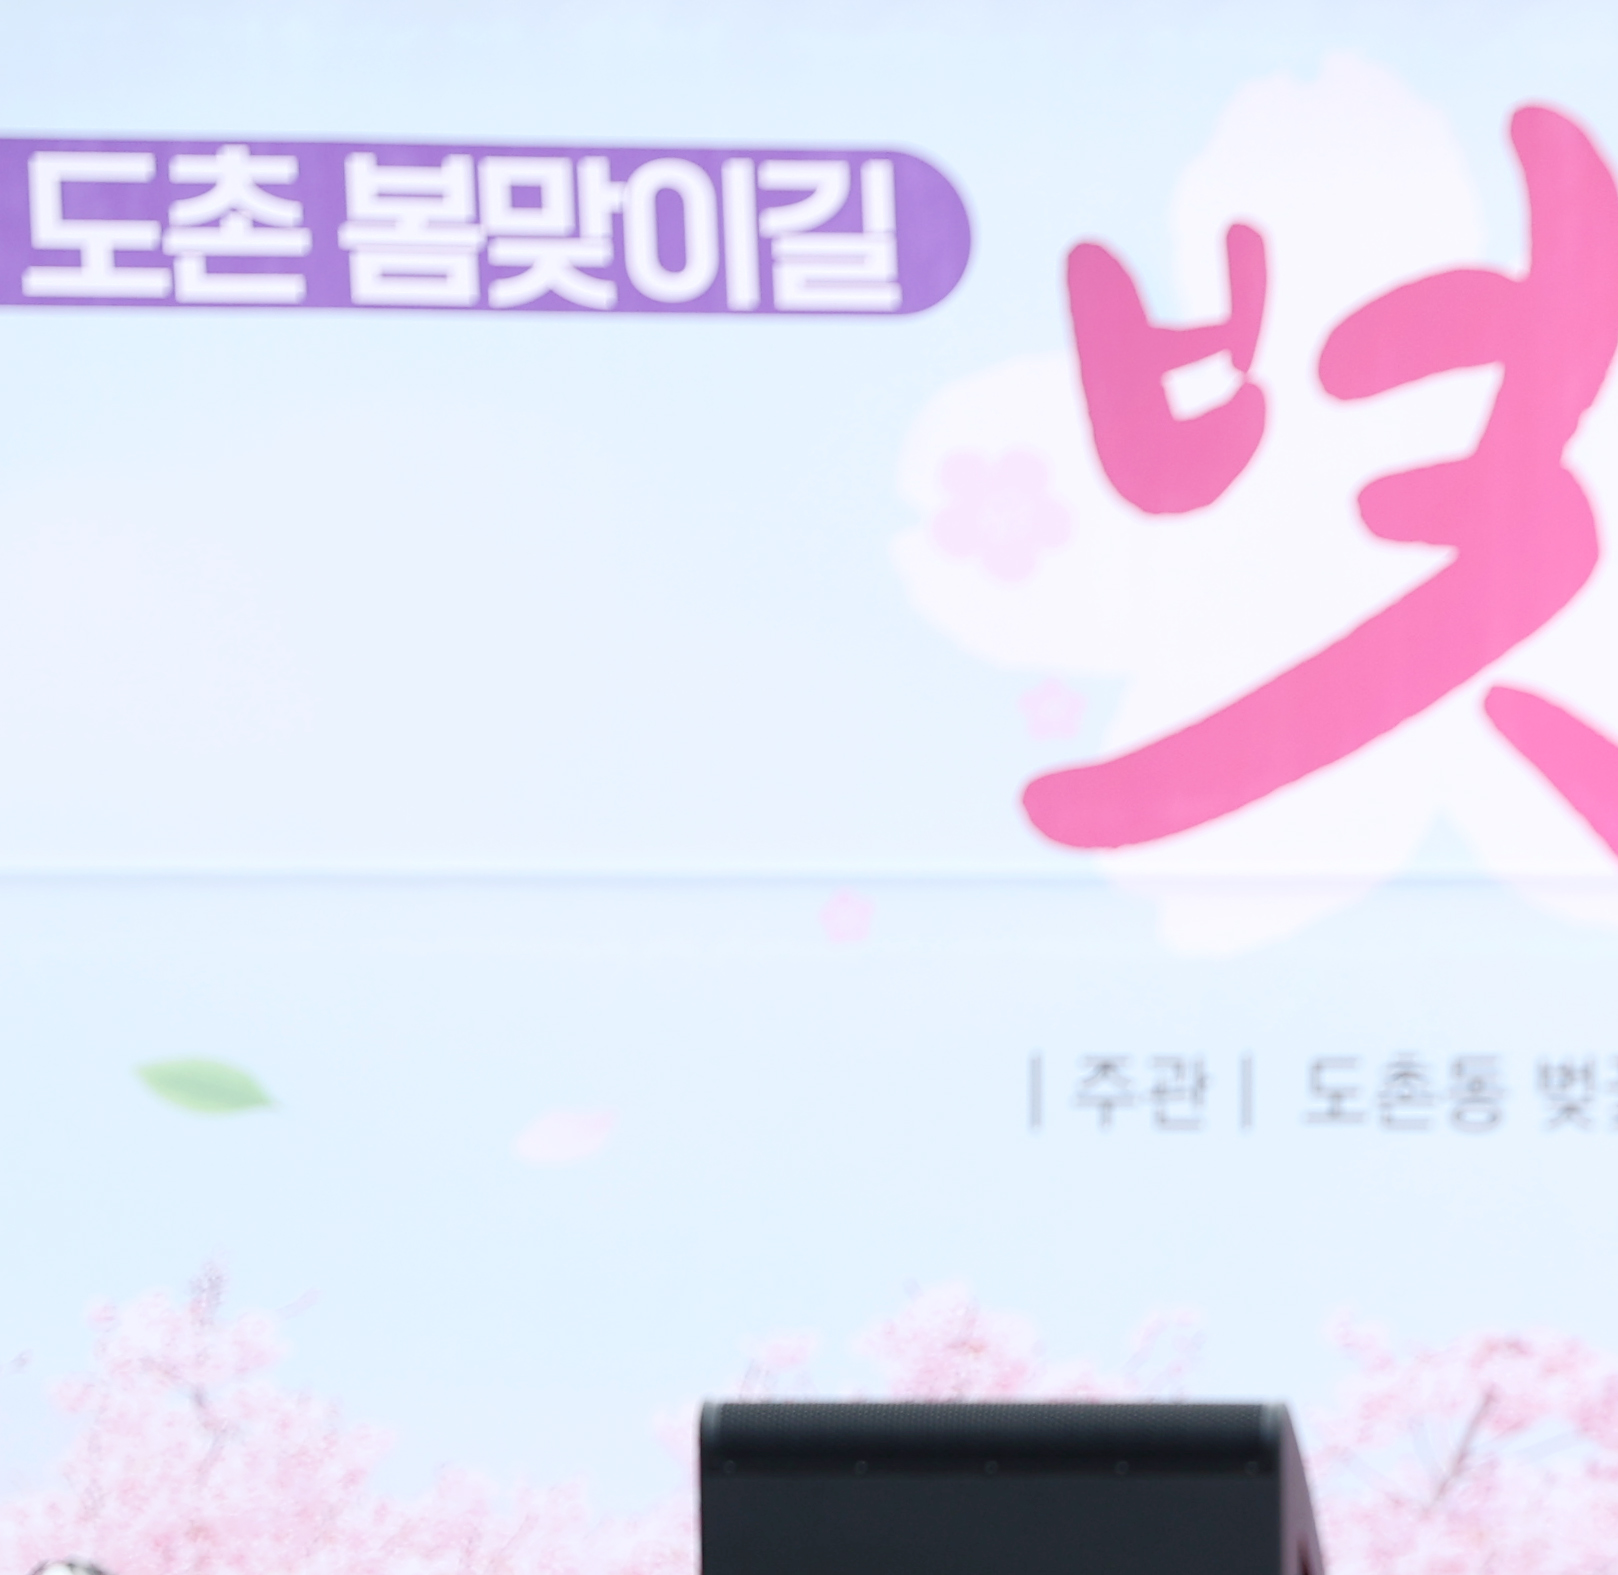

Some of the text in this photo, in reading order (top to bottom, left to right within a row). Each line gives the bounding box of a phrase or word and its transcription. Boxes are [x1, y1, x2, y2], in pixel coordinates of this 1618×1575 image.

[24, 146, 902, 311] 도촌 봄맞이길
[1075, 1053, 1210, 1132] 주관
[1305, 1052, 1506, 1132] 도촌동
